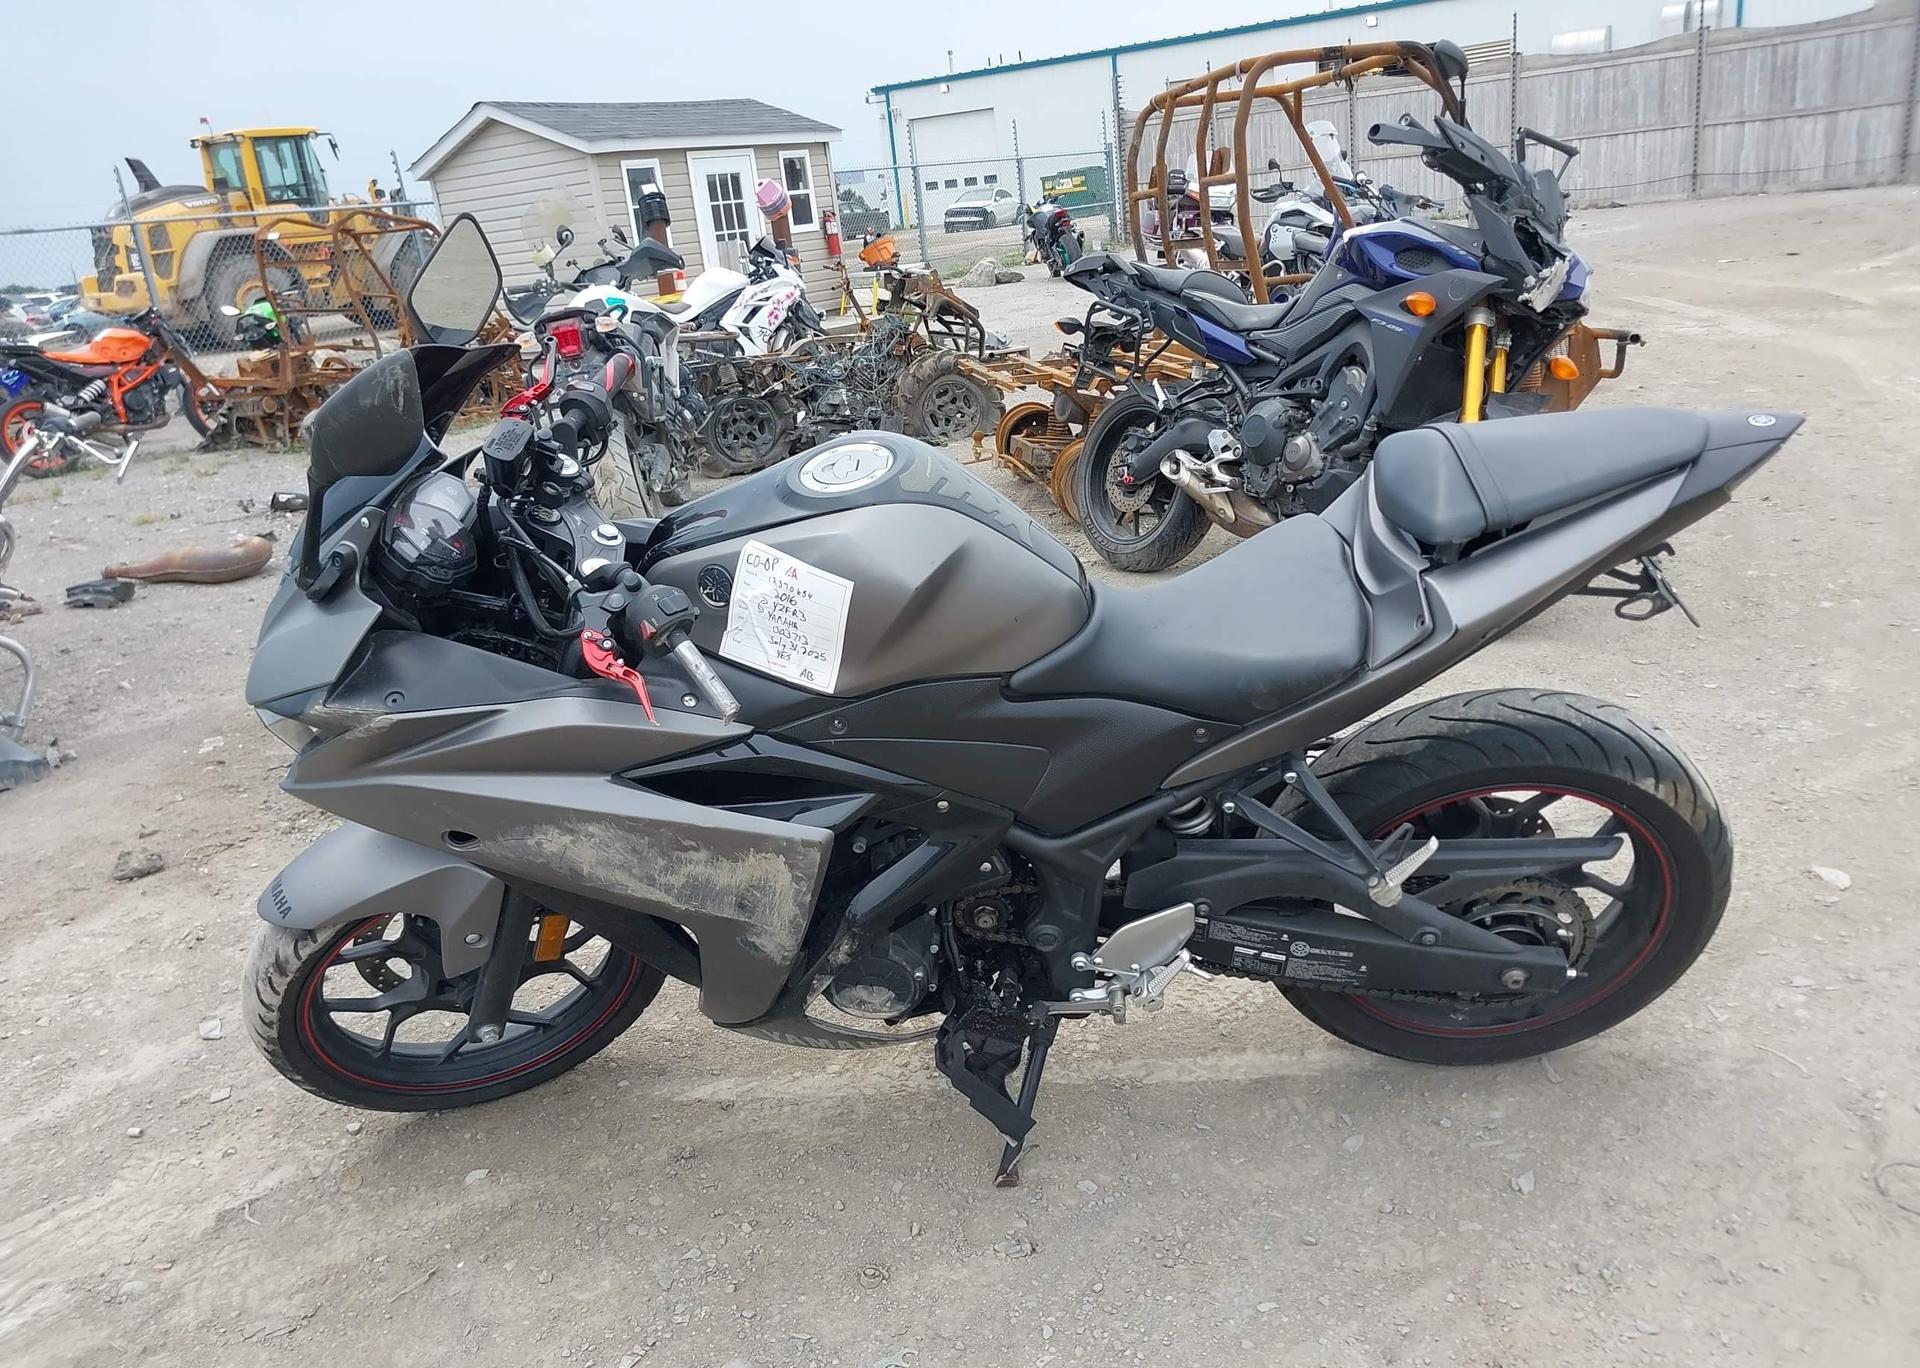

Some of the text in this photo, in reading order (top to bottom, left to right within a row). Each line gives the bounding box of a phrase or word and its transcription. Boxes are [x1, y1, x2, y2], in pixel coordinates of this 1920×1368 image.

[185, 198, 218, 208] VOLVO
[772, 587, 798, 607] 2016
[767, 634, 787, 651] July
[800, 645, 828, 662] 2025
[776, 649, 792, 661] YES
